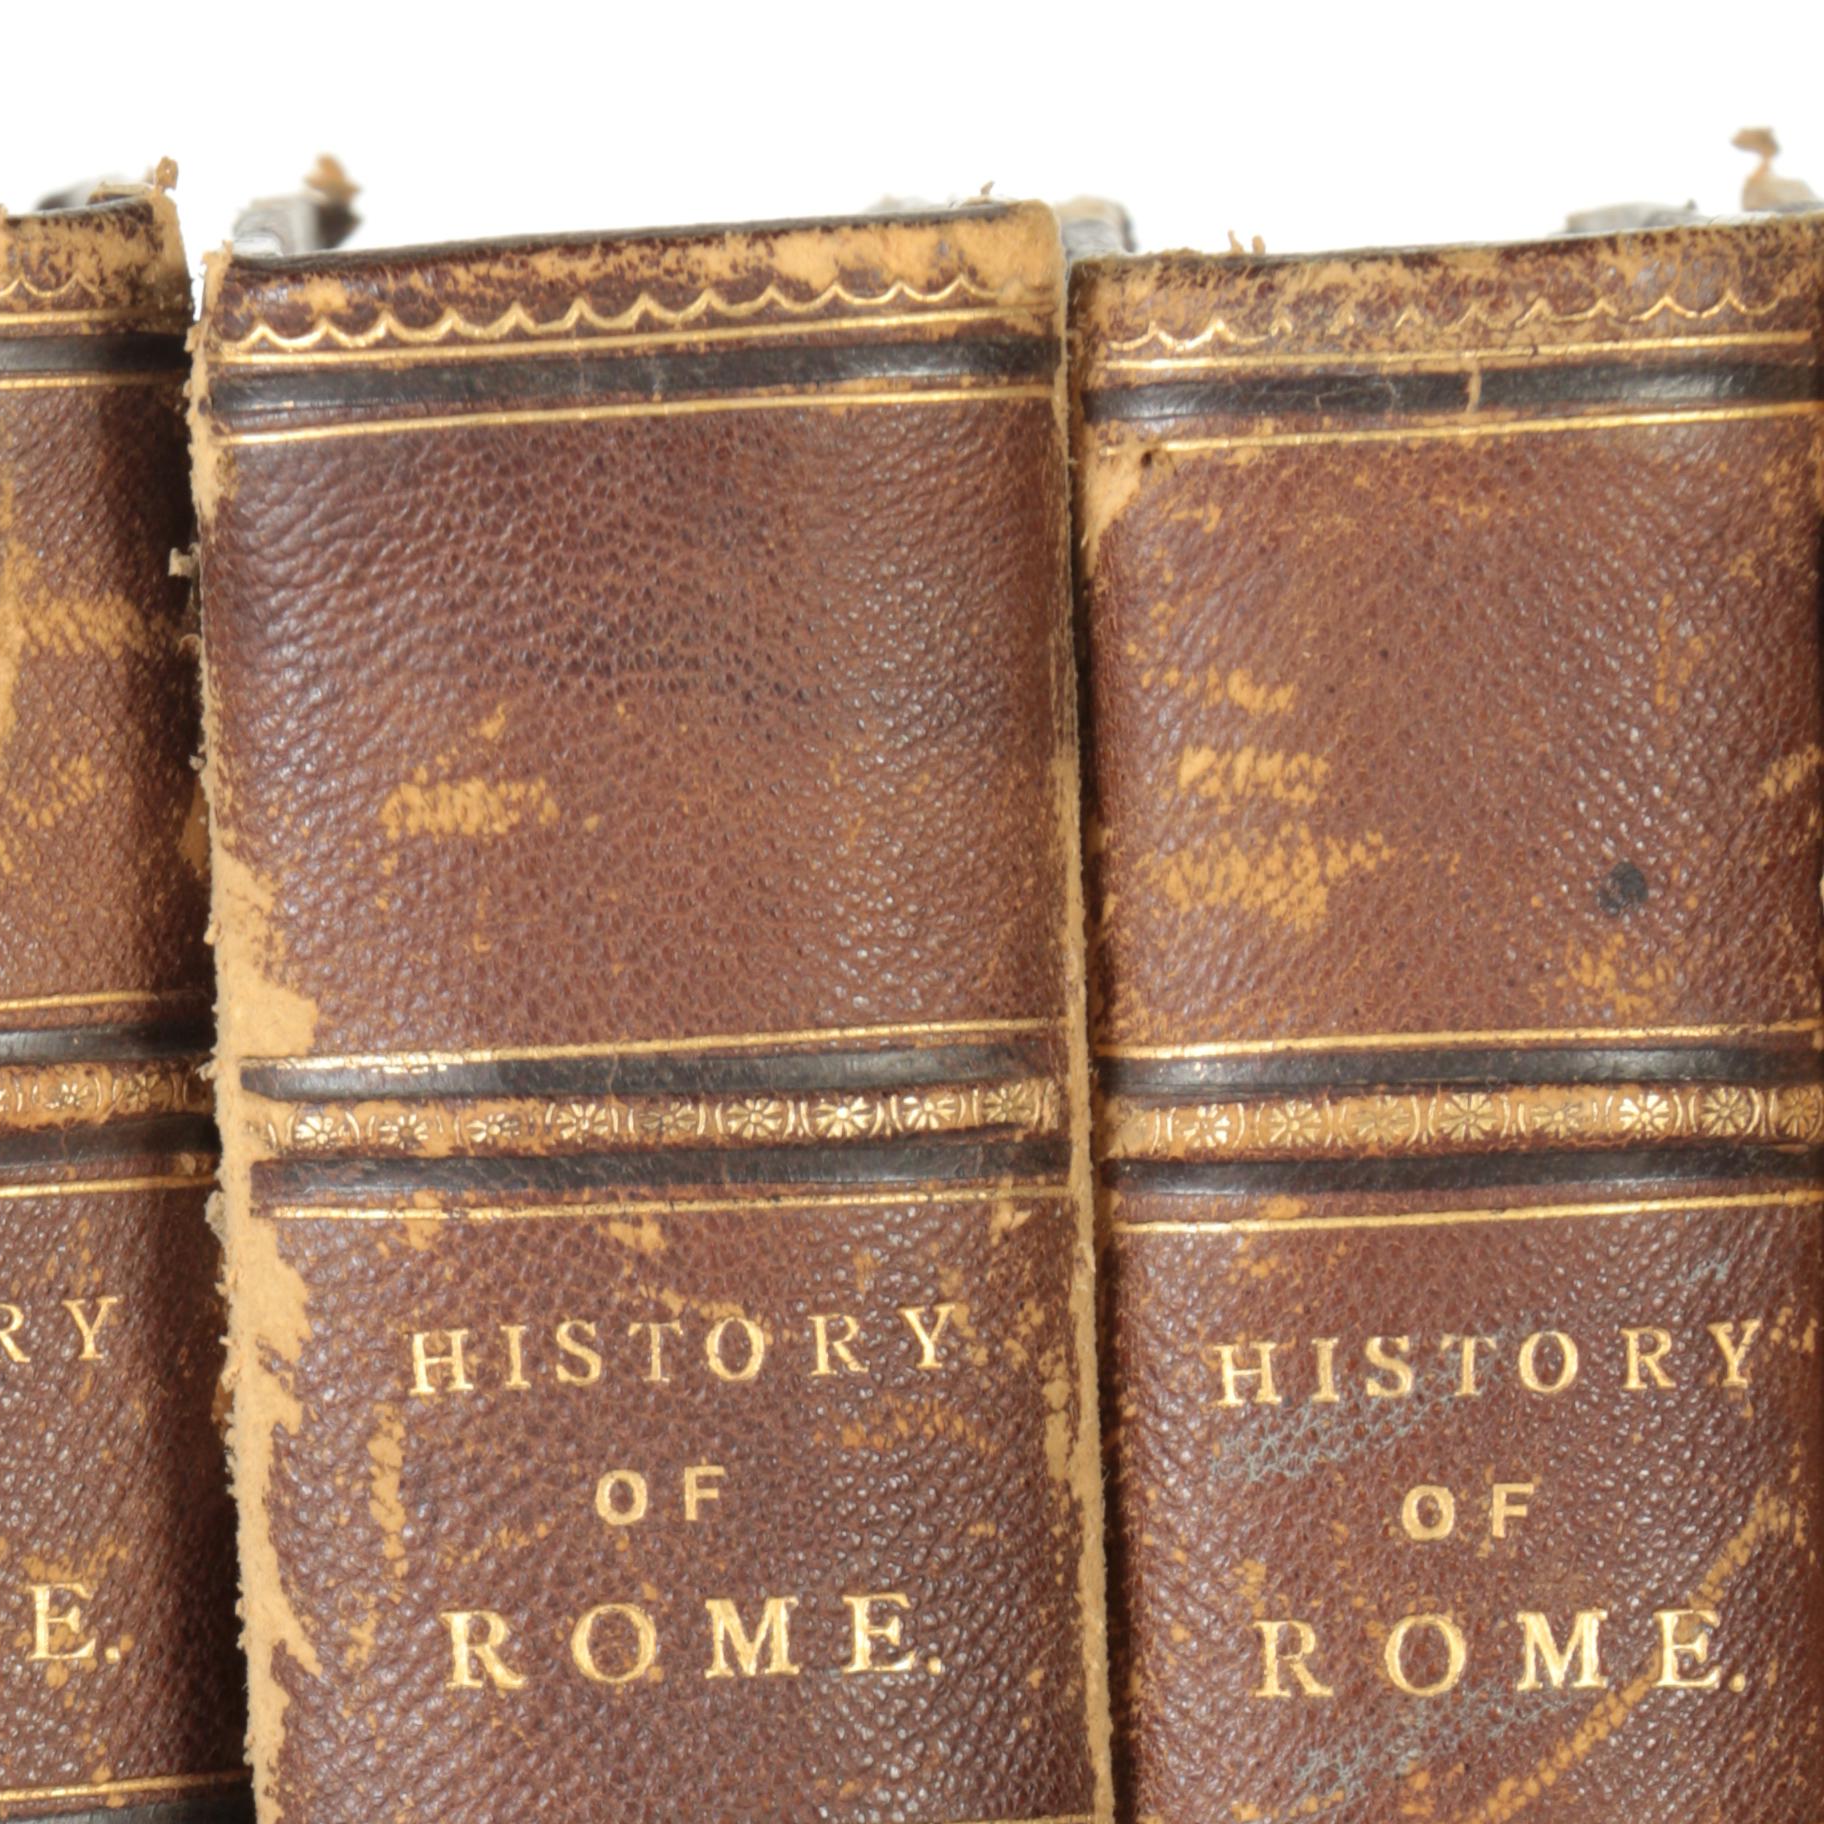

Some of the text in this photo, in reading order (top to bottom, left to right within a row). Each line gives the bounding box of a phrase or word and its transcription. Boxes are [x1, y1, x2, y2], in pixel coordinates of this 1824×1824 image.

[409, 1303, 956, 1396] HISTORY
[1214, 1319, 1763, 1407] HISTORY
[595, 1465, 727, 1525] OF
[1400, 1483, 1534, 1542] OF
[439, 1593, 942, 1689] ROME.
[1254, 1609, 1747, 1699] ROME.
